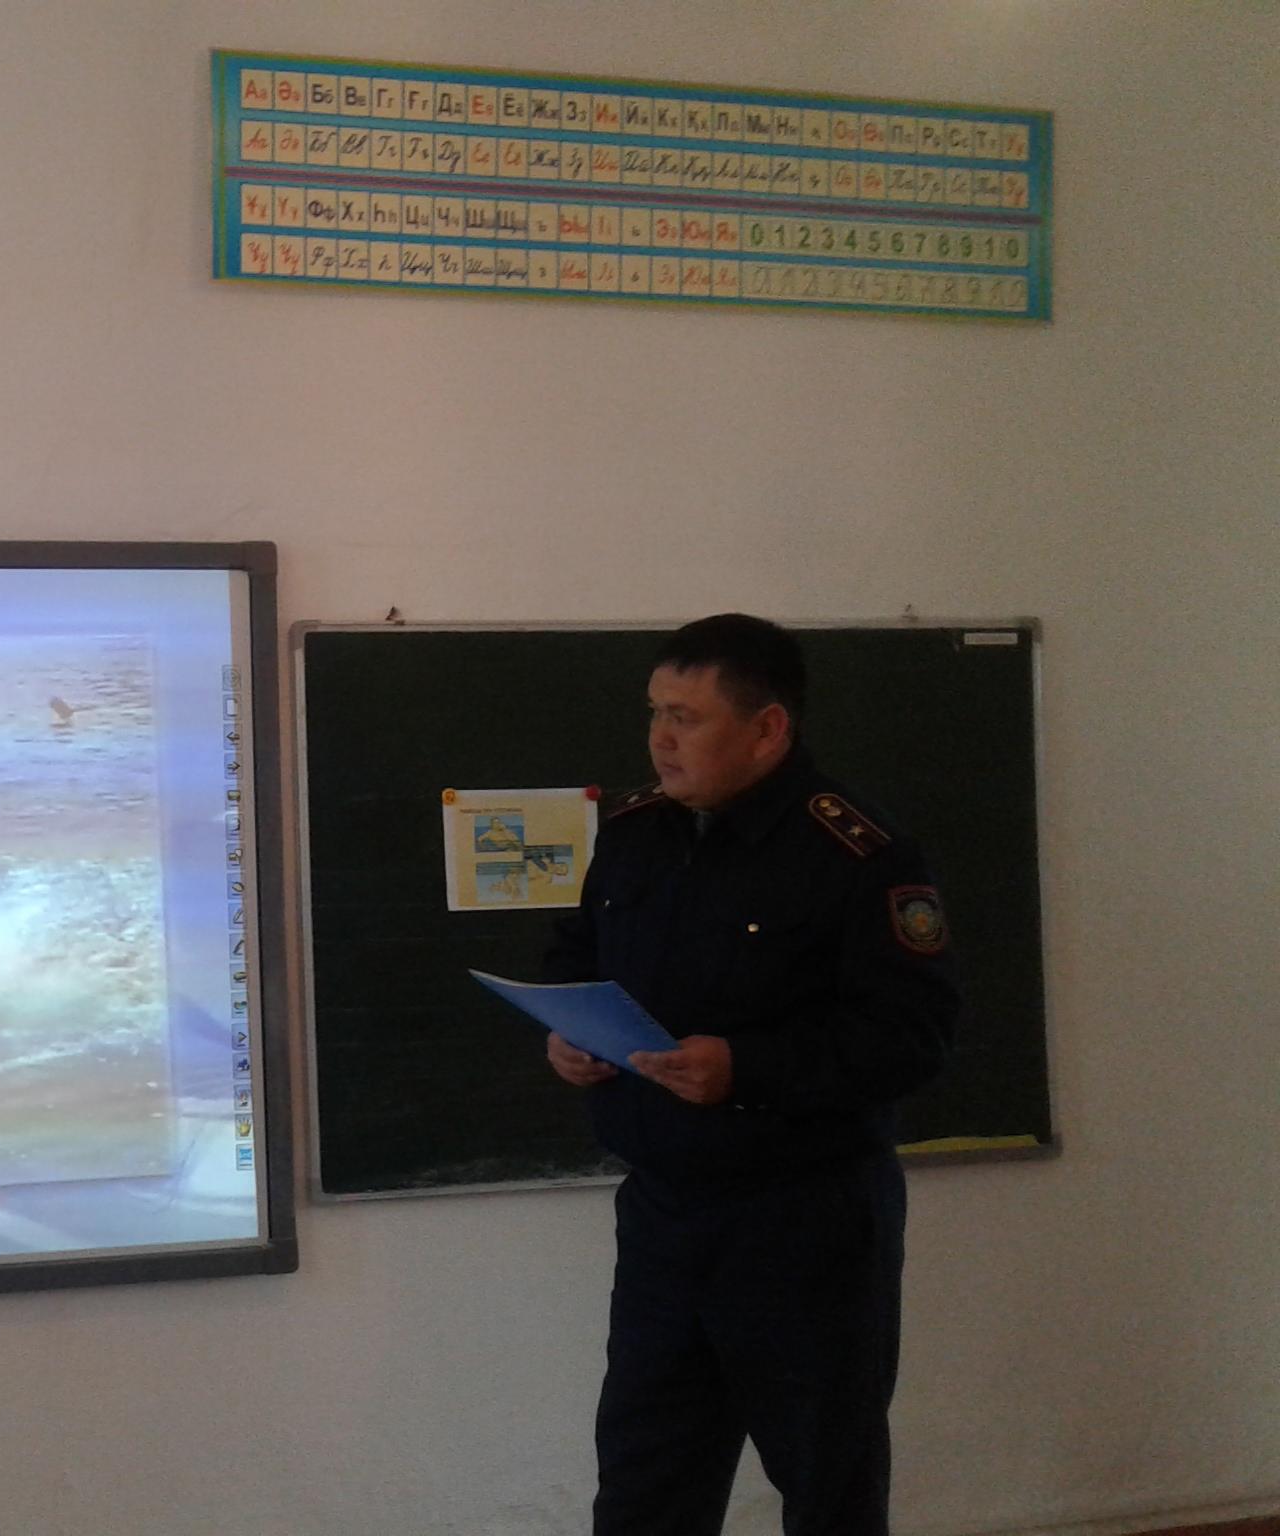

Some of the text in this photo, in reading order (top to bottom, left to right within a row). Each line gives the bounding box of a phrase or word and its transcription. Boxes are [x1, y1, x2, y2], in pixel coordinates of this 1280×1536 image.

[312, 84, 334, 103] Бб
[377, 89, 394, 108] Гг
[751, 224, 764, 246] 0
[775, 225, 784, 246] 1
[798, 226, 810, 248] 2
[822, 227, 834, 250] 3
[844, 229, 857, 250] 4
[868, 231, 880, 252] 5
[891, 232, 904, 253] 6
[914, 233, 927, 253] 7
[937, 234, 949, 255] 8
[960, 237, 972, 258] 9
